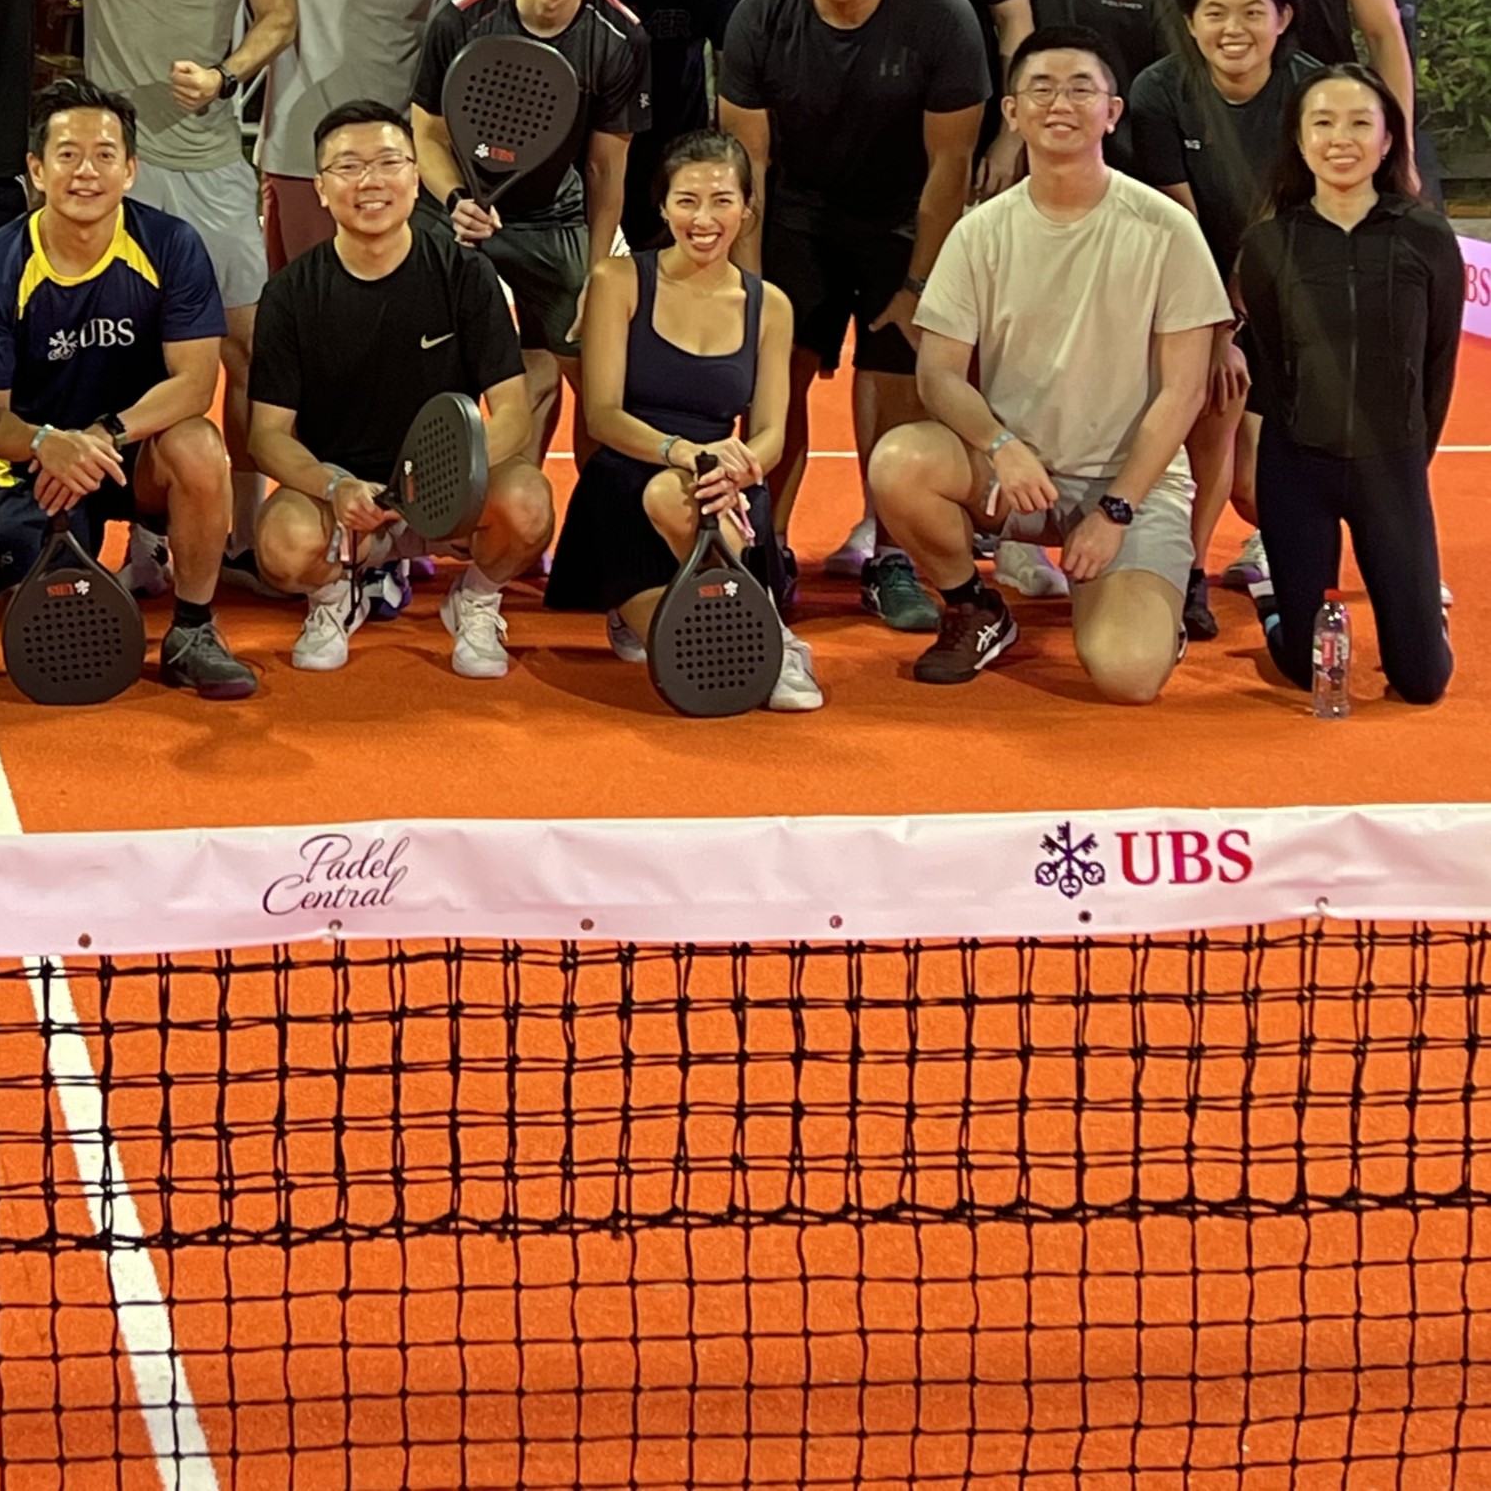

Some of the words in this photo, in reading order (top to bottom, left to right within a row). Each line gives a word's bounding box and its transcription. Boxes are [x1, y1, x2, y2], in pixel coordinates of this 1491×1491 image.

[79, 317, 136, 349] UBS
[299, 833, 410, 884] Padel
[1114, 829, 1253, 886] UBS
[262, 865, 409, 916] Central
